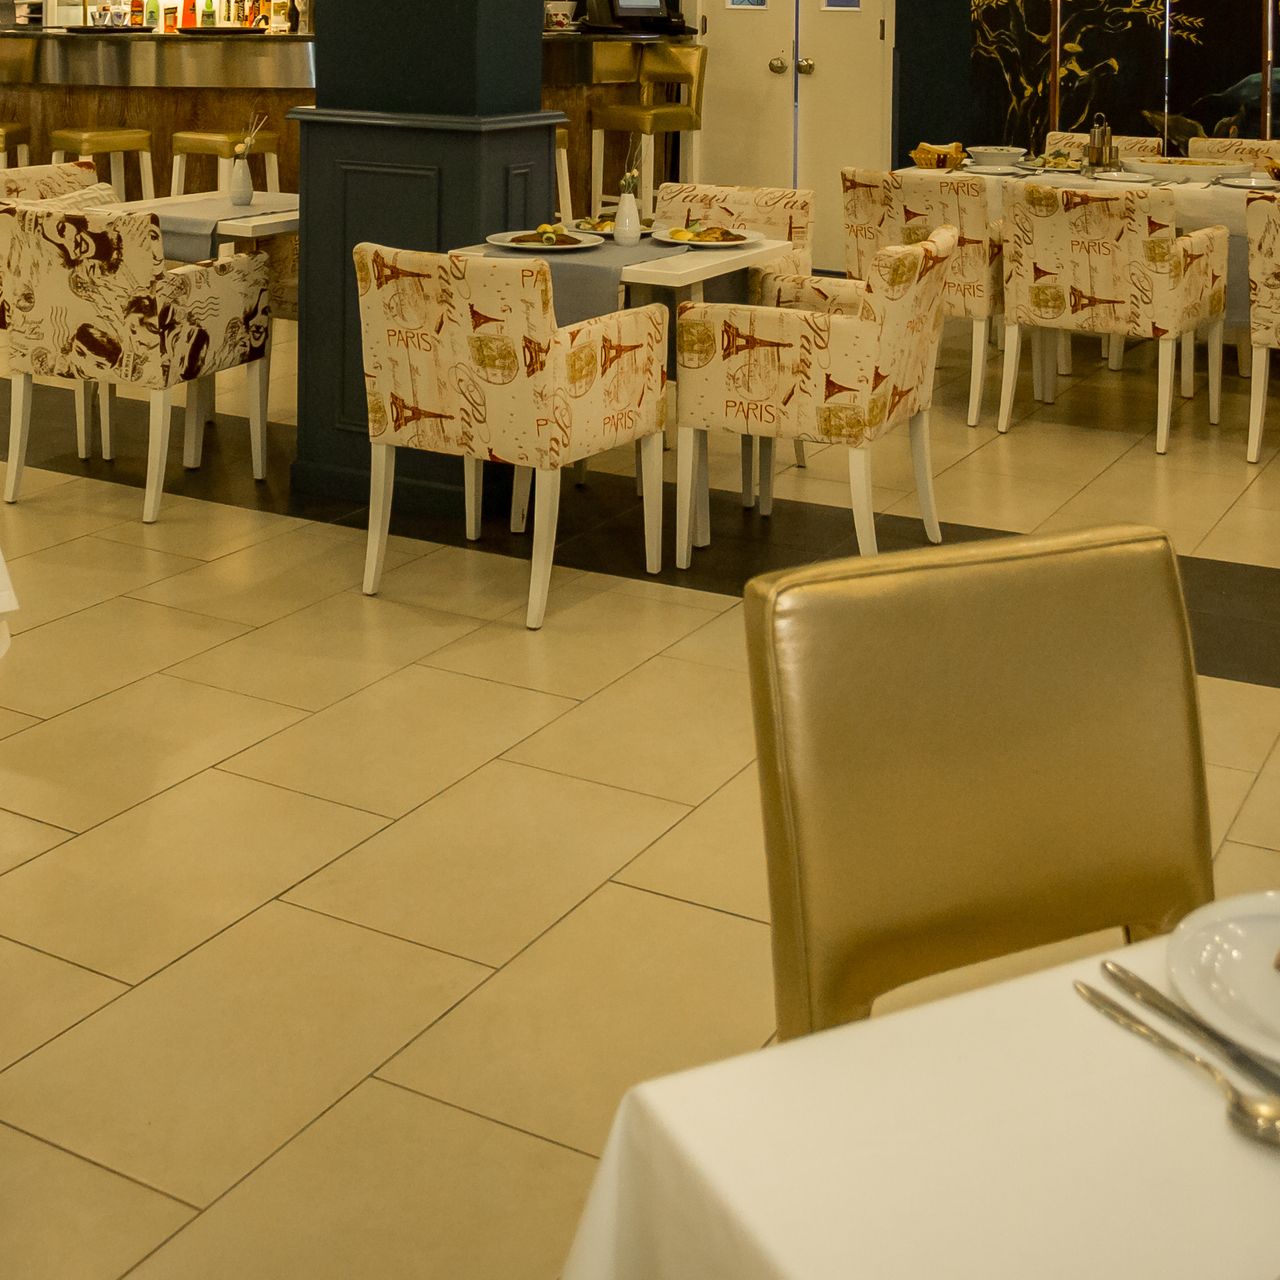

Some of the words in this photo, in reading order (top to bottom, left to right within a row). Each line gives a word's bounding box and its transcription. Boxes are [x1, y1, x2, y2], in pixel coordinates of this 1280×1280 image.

[660, 184, 731, 205] Paris
[939, 181, 980, 198] PARIS
[1071, 239, 1112, 257] PARIS
[947, 280, 985, 299] PARIS
[387, 328, 433, 353] PARIS
[798, 313, 832, 398] Paris
[602, 408, 635, 437] PARIS
[724, 399, 776, 424] PARIS
